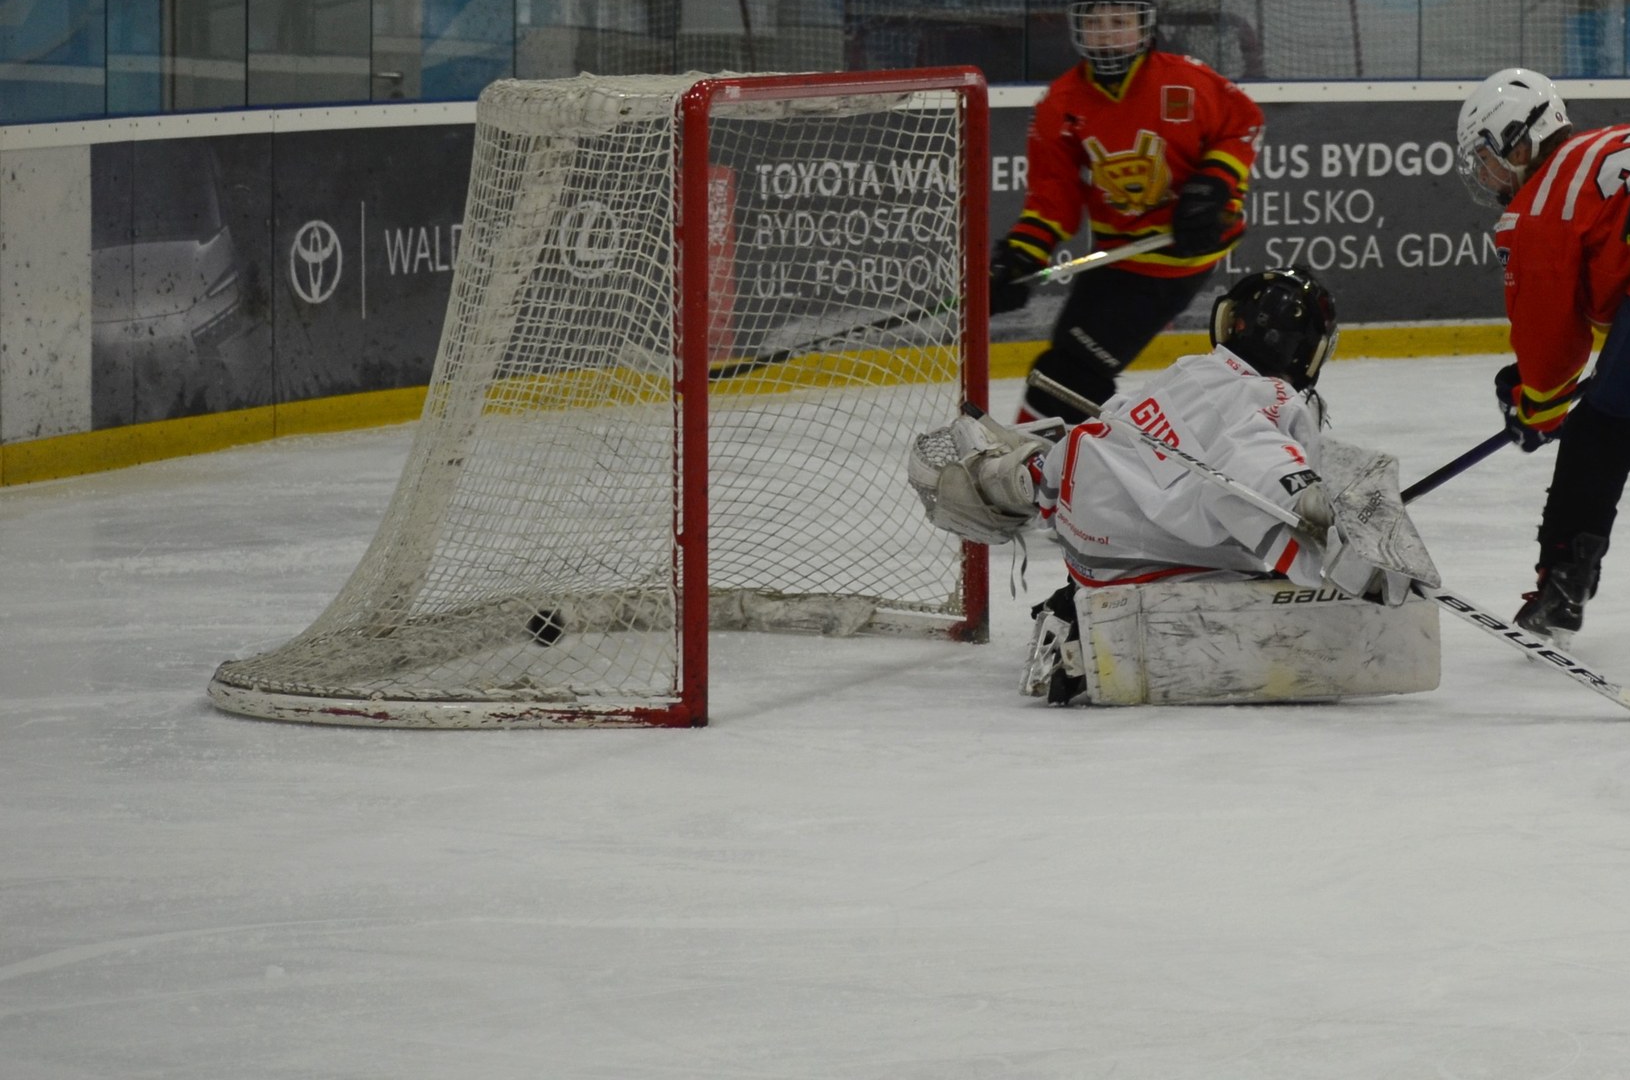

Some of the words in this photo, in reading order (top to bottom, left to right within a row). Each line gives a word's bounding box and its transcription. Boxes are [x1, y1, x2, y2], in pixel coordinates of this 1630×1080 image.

[755, 161, 881, 201] TOYOTA
[1243, 188, 1385, 229] IELSKO,
[1265, 235, 1384, 271] SZOSA
[1435, 595, 1608, 687] BAUER
